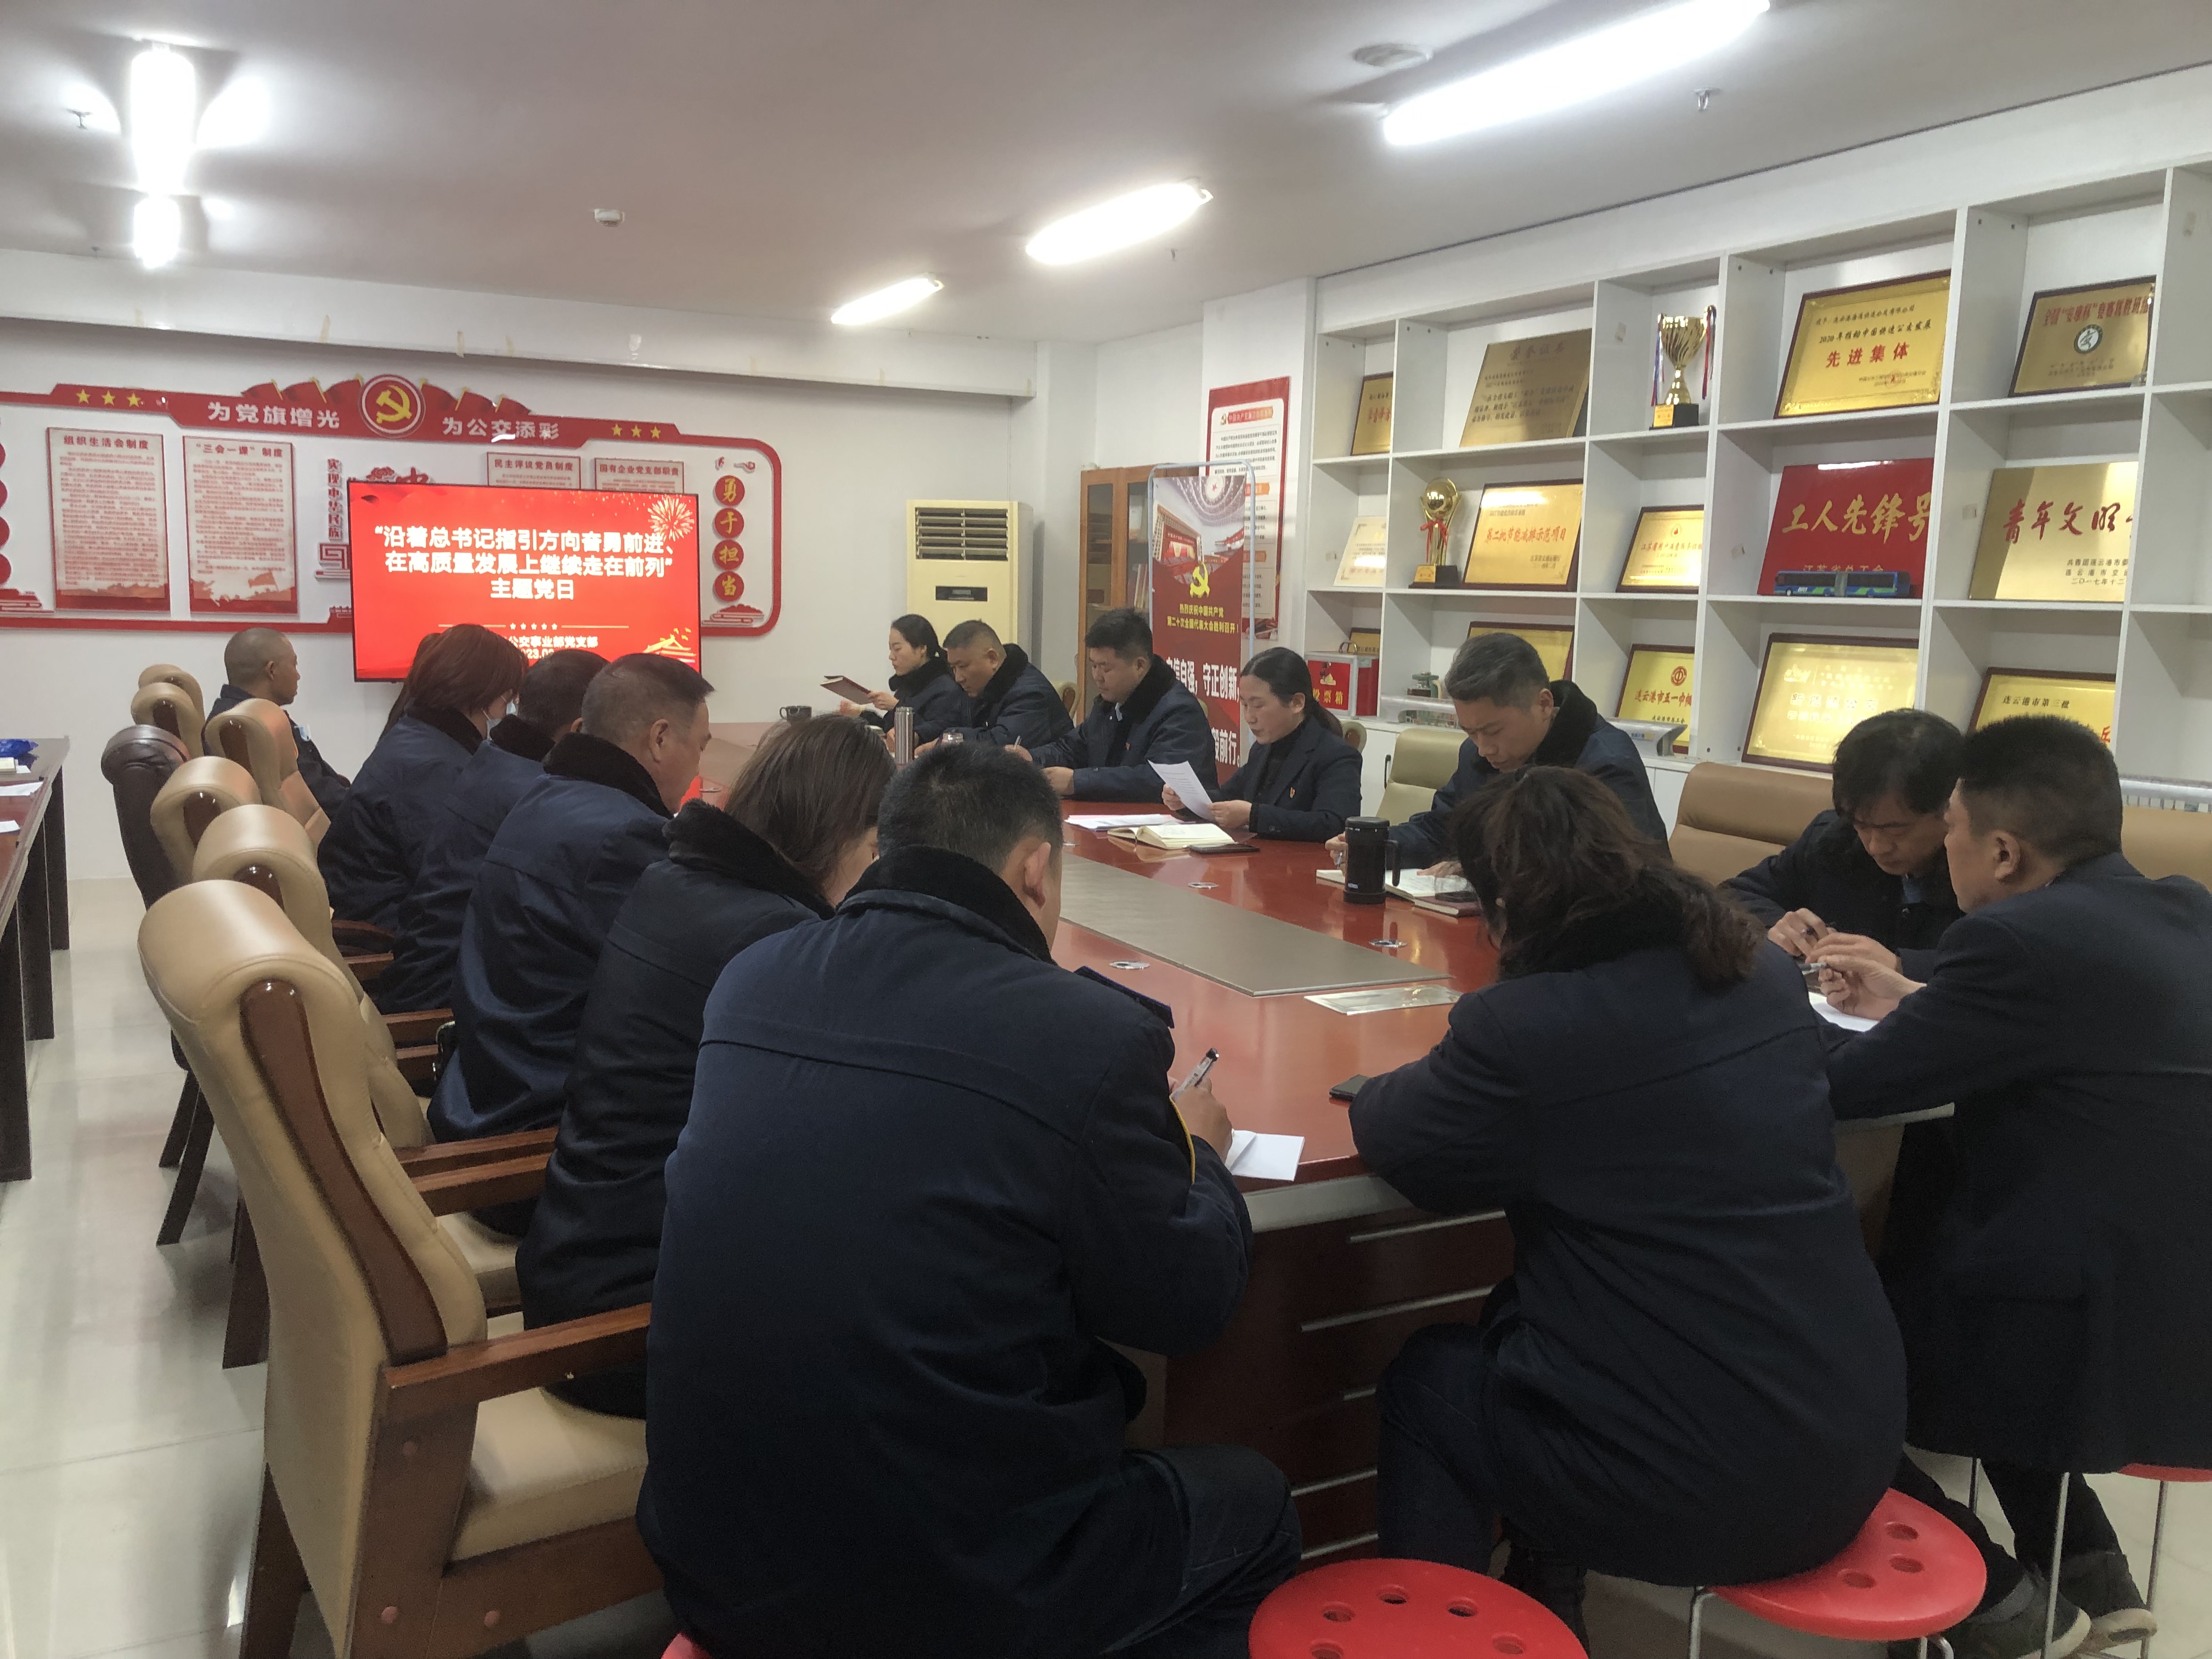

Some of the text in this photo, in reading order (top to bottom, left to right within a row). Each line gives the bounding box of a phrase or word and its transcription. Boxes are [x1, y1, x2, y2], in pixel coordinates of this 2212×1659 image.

[1826, 341, 1909, 368] 先进集体
[208, 402, 340, 428] 为党旗增光
[442, 417, 559, 442] 为公交添彩
[64, 435, 149, 450] 组织生活会制度
[495, 459, 573, 471] 民主评议党员制度
[600, 464, 679, 476] 国有企业党支部职责
[1782, 493, 1932, 544] 工人先锋号
[2003, 499, 2133, 544] 青年文明
[375, 525, 674, 556] “沿着总书记指引方向奋勇前进、
[719, 478, 740, 596] 勇于担当
[385, 550, 673, 578] 在高质量发展上继续走在前列”
[490, 577, 575, 600] 主题党日
[1180, 603, 1224, 618] 热烈庆祝中国共产党
[504, 635, 599, 649] 公交事业部党支部
[2002, 695, 2070, 709] 连云港市第三批
